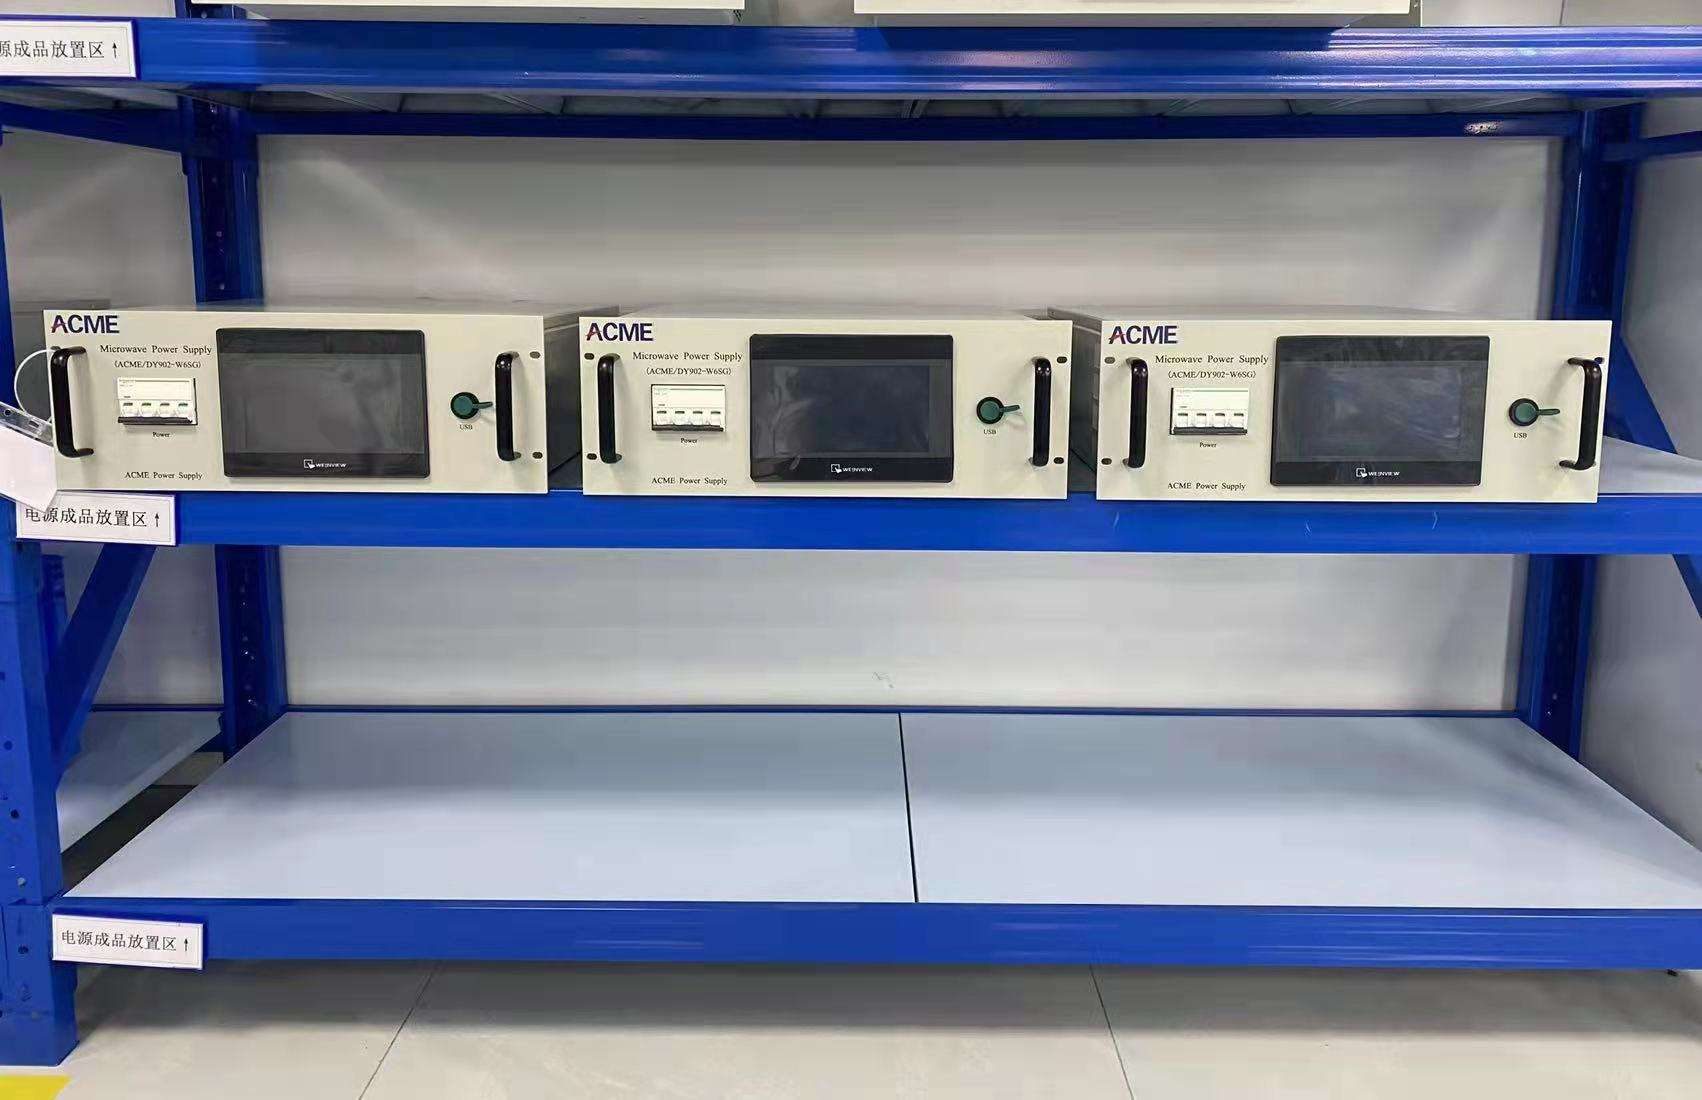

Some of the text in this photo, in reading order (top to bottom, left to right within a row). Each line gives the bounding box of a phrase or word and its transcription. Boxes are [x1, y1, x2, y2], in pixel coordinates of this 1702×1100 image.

[51, 315, 120, 334] ACME
[586, 323, 653, 341] ACME
[1109, 326, 1177, 344] ACME
[99, 344, 213, 356] Microwave Power Supply
[632, 351, 743, 363] Microwave Power Supply
[1154, 355, 1269, 365] Microwave Power Supply
[151, 431, 171, 439] Power
[983, 428, 997, 436] USB
[1198, 441, 1218, 449] Power
[124, 471, 203, 481] ACME Power Supply
[651, 477, 728, 486] ACME Power Supply
[1167, 482, 1247, 491] ACME Power Supply
[25, 508, 147, 527] 电源成品放置区
[62, 930, 176, 951] 电源成品放置区
